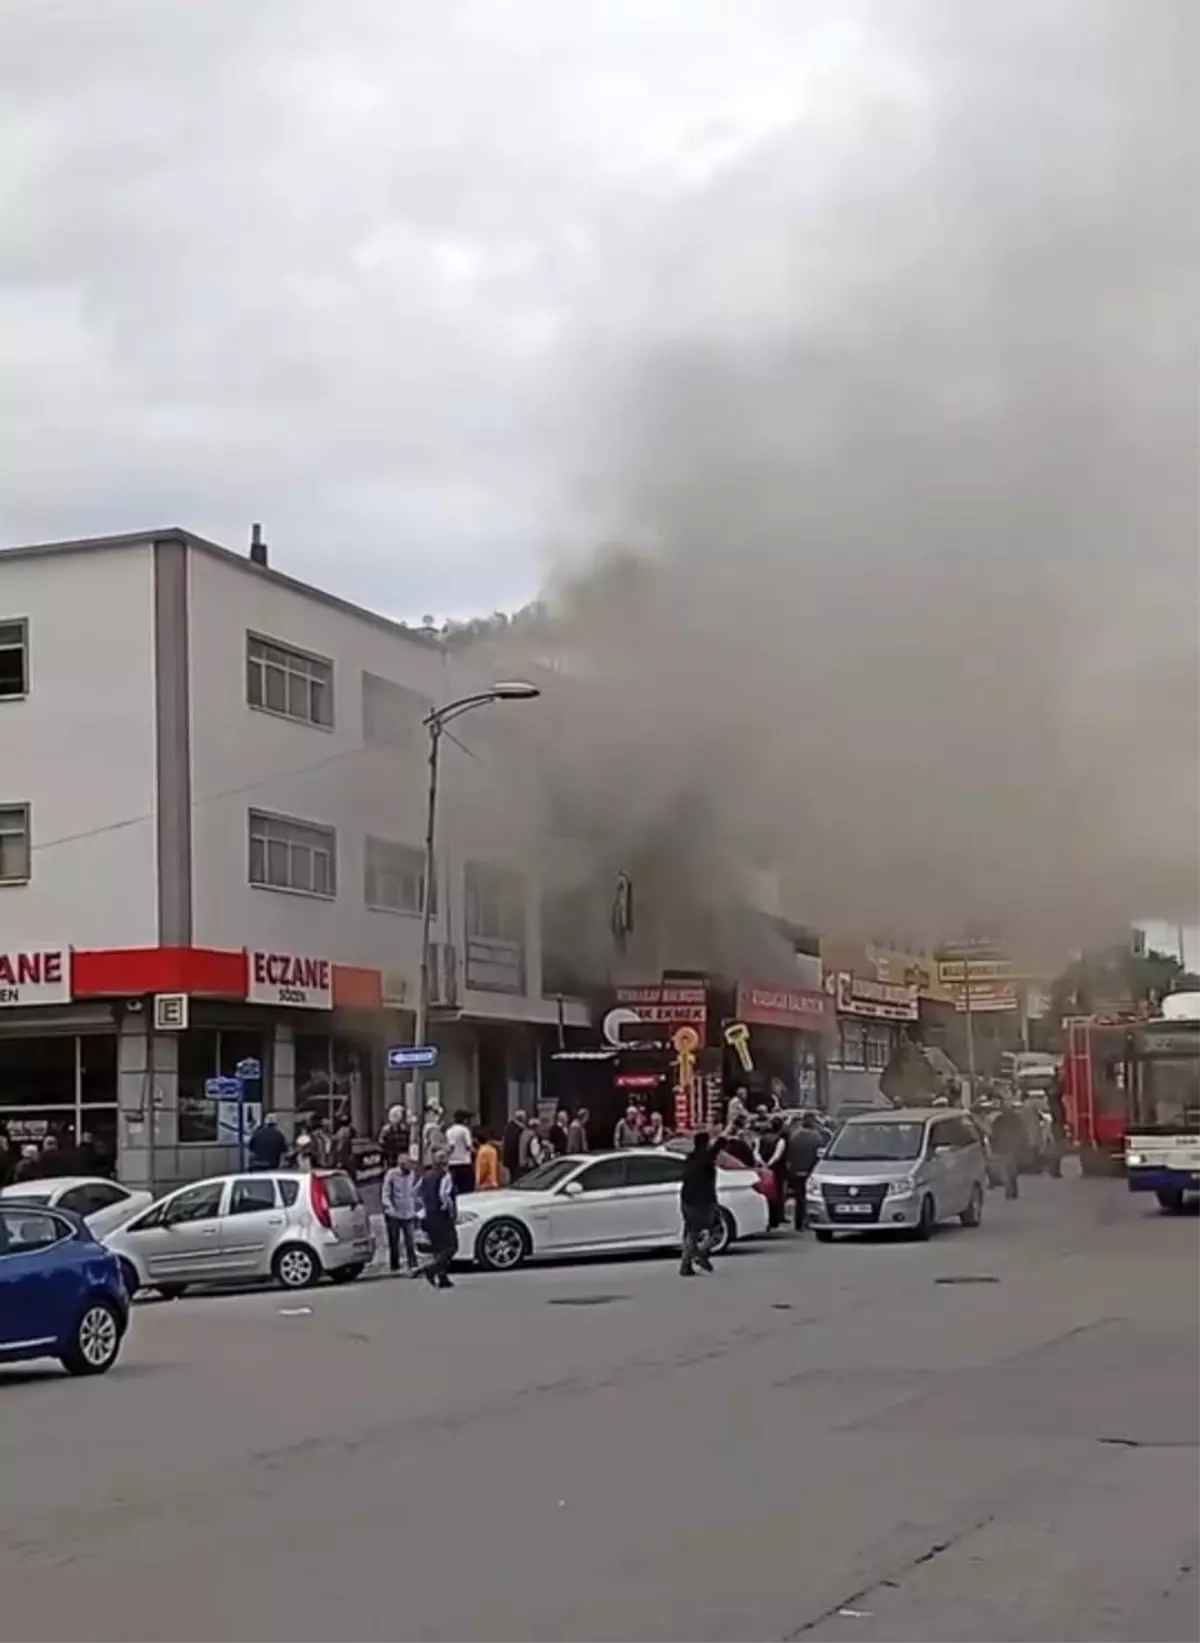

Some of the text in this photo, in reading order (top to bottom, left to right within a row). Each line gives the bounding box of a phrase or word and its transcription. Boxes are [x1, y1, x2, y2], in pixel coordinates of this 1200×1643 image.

[0, 951, 62, 985] ANE
[254, 952, 329, 990] ECZANE
[164, 1002, 178, 1022] E
